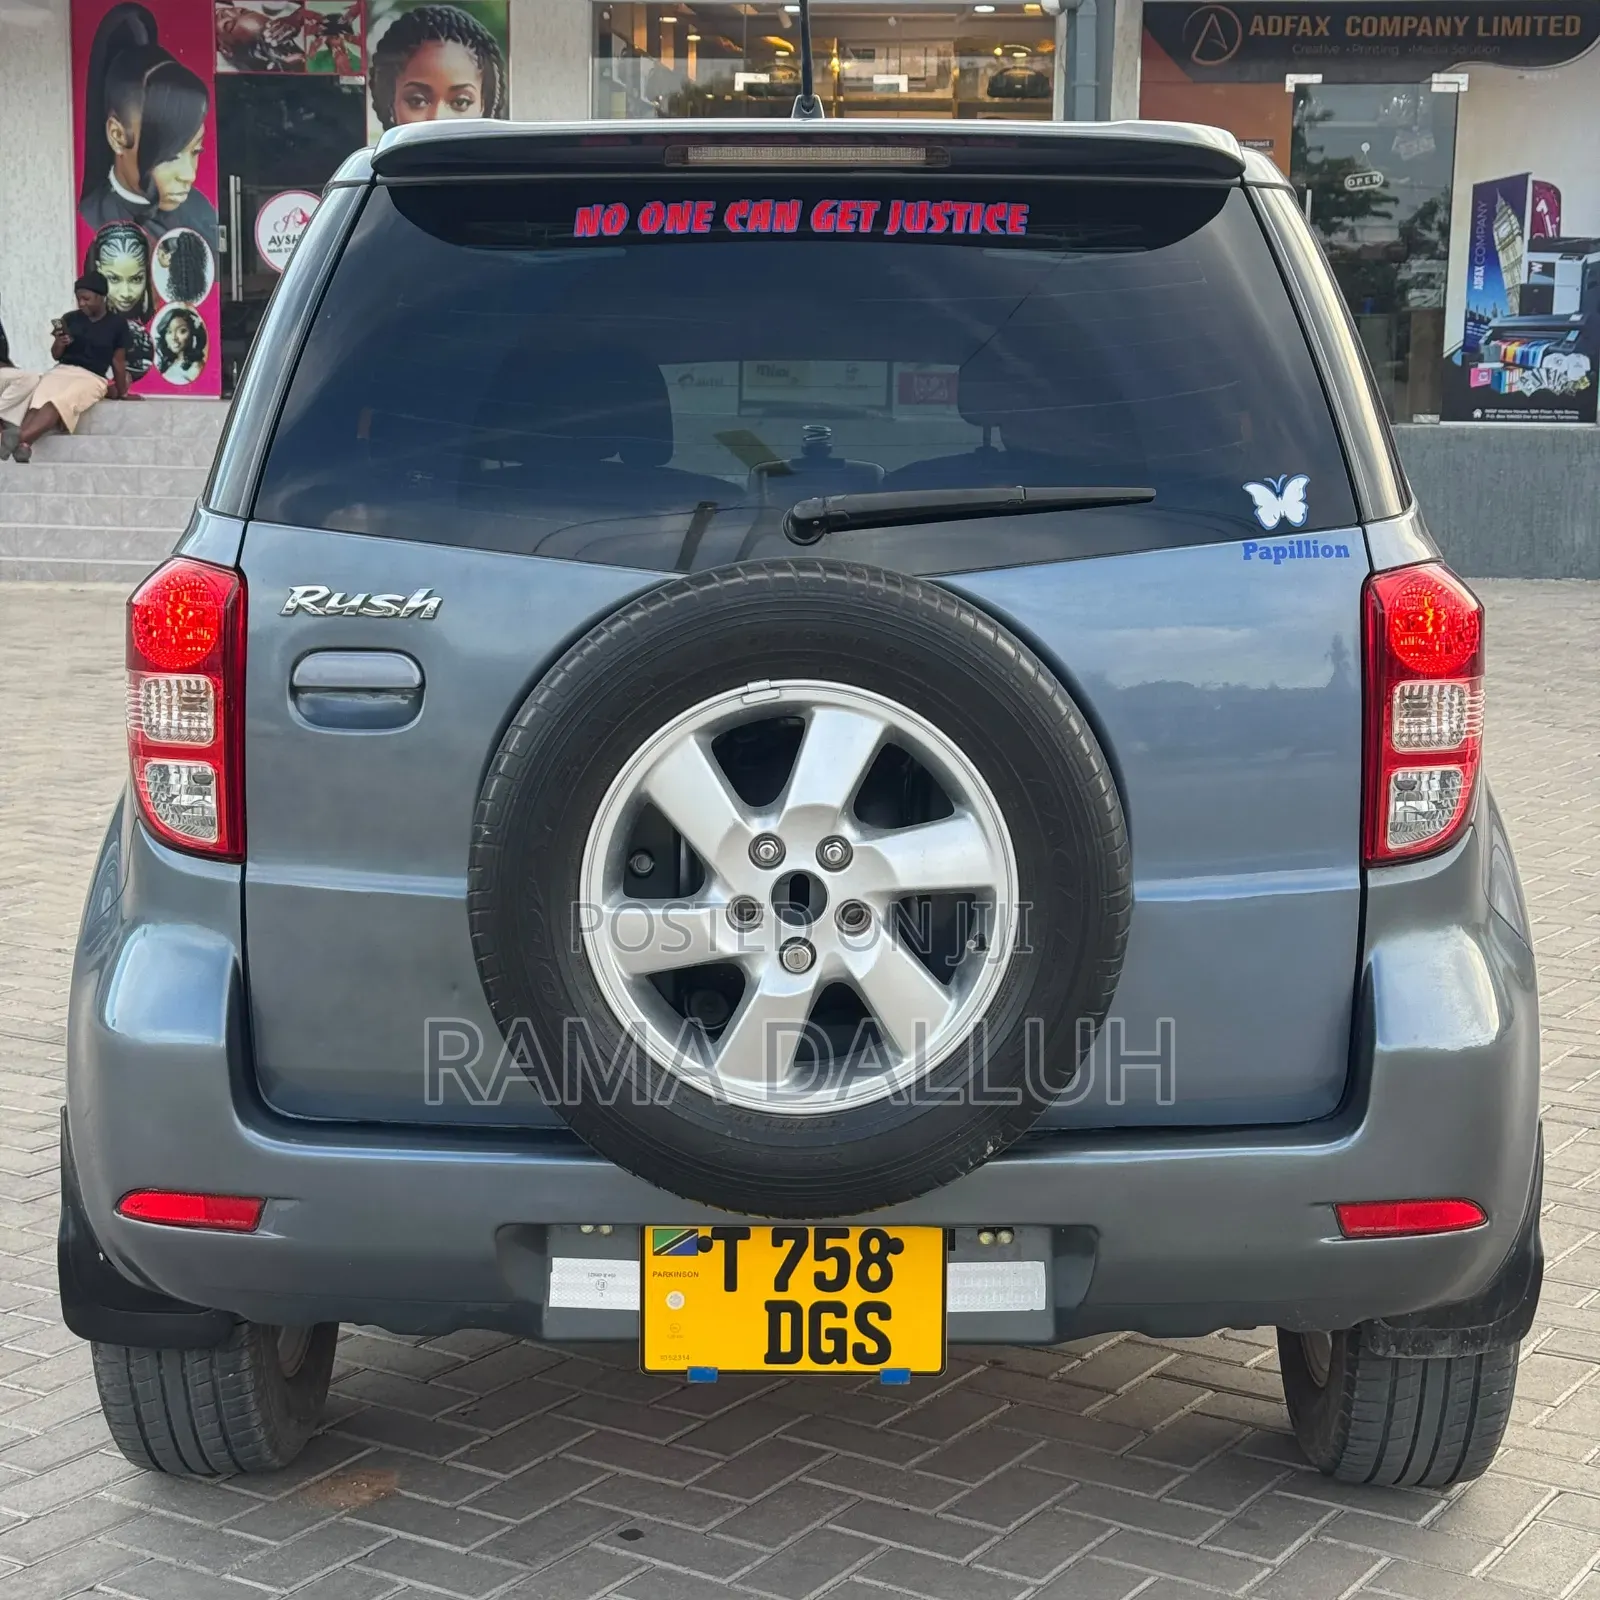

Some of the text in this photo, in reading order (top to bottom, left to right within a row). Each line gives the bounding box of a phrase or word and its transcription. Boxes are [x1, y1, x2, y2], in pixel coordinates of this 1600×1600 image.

[1249, 15, 1582, 37] ADFAX COMPANY LIMITED
[1347, 174, 1380, 187] OPEN
[573, 199, 1029, 238] NO ONE CAN GET JUSTICE
[1474, 200, 1488, 290] ADFAX COMPANY
[1242, 540, 1350, 565] Papillion
[278, 584, 443, 619] Rush
[652, 1270, 699, 1278] PARKINSON
[711, 1226, 892, 1293] T 758
[764, 1300, 892, 1365] DGS
